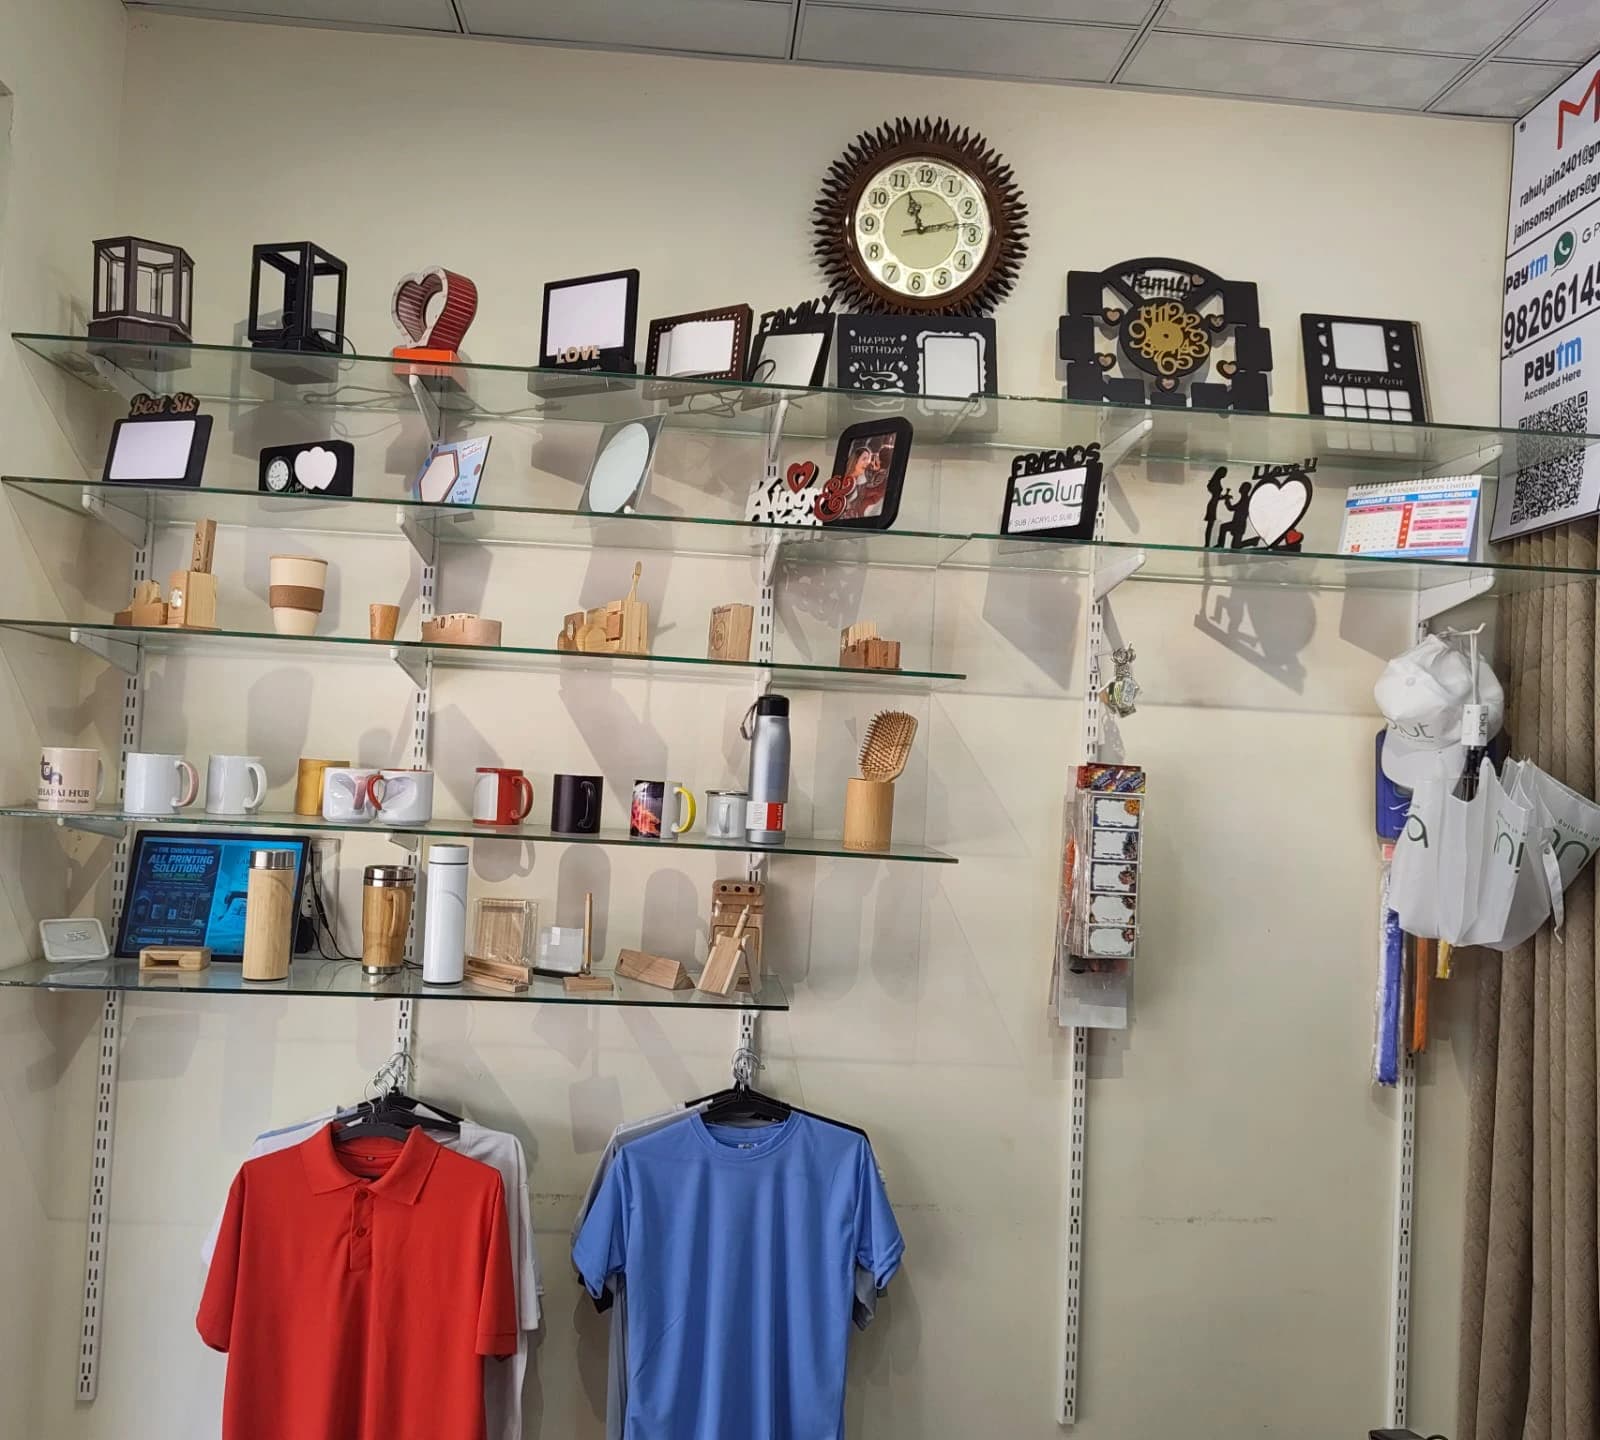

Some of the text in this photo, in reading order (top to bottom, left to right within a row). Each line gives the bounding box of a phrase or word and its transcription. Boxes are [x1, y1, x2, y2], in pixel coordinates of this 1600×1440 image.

[893, 174, 906, 188] 11
[919, 168, 933, 184] 12
[948, 179, 955, 193] 1
[873, 191, 887, 204] 10
[965, 200, 973, 215] 2
[864, 217, 875, 232] 9
[967, 227, 977, 243] 3
[869, 245, 879, 260] 8
[958, 254, 967, 270] 4
[887, 265, 897, 280] 7
[939, 271, 948, 285] 5
[911, 275, 921, 290] 6
[759, 289, 838, 333] FAMILY
[858, 335, 897, 345] HAPPY
[1128, 320, 1149, 348] 9
[850, 345, 904, 355] BIRTHDAY
[1190, 330, 1210, 358] 3
[555, 345, 600, 364] LOVE
[1324, 373, 1344, 384] My
[1524, 369, 1582, 402] Accepted Here
[1012, 442, 1101, 477] FRIENDS
[68, 789, 90, 798] HUB
[148, 854, 215, 865] ALL PRINTING
[152, 864, 206, 873] SOLUTIONS
